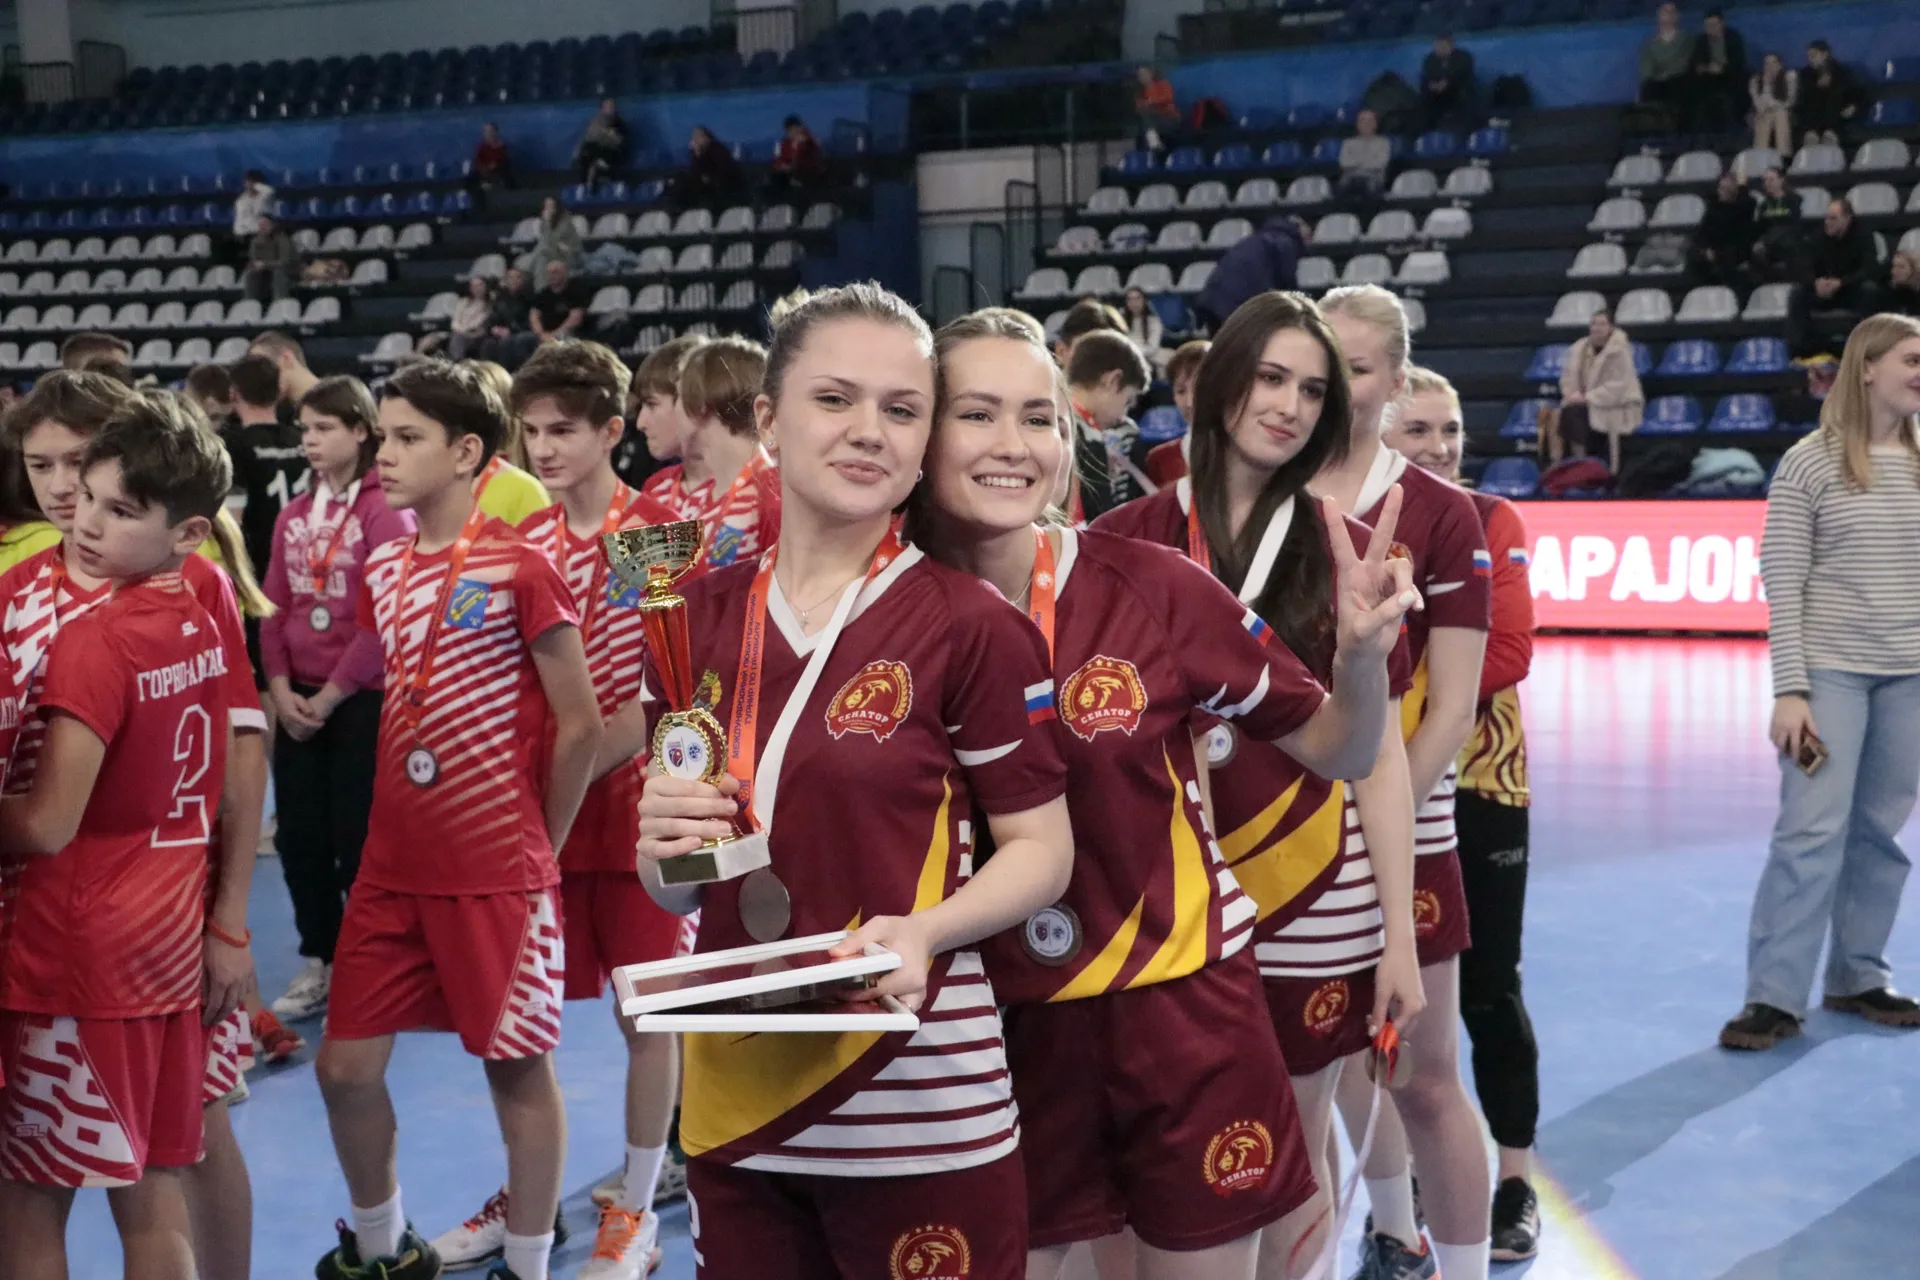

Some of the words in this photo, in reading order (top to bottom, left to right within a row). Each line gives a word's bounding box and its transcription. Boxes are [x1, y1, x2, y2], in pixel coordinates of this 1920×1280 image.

[837, 710, 889, 723] СЕНАТОР
[1080, 708, 1132, 724] СЕНАТОР
[150, 703, 211, 848] 2
[1220, 1167, 1265, 1186] СЕНАТОР
